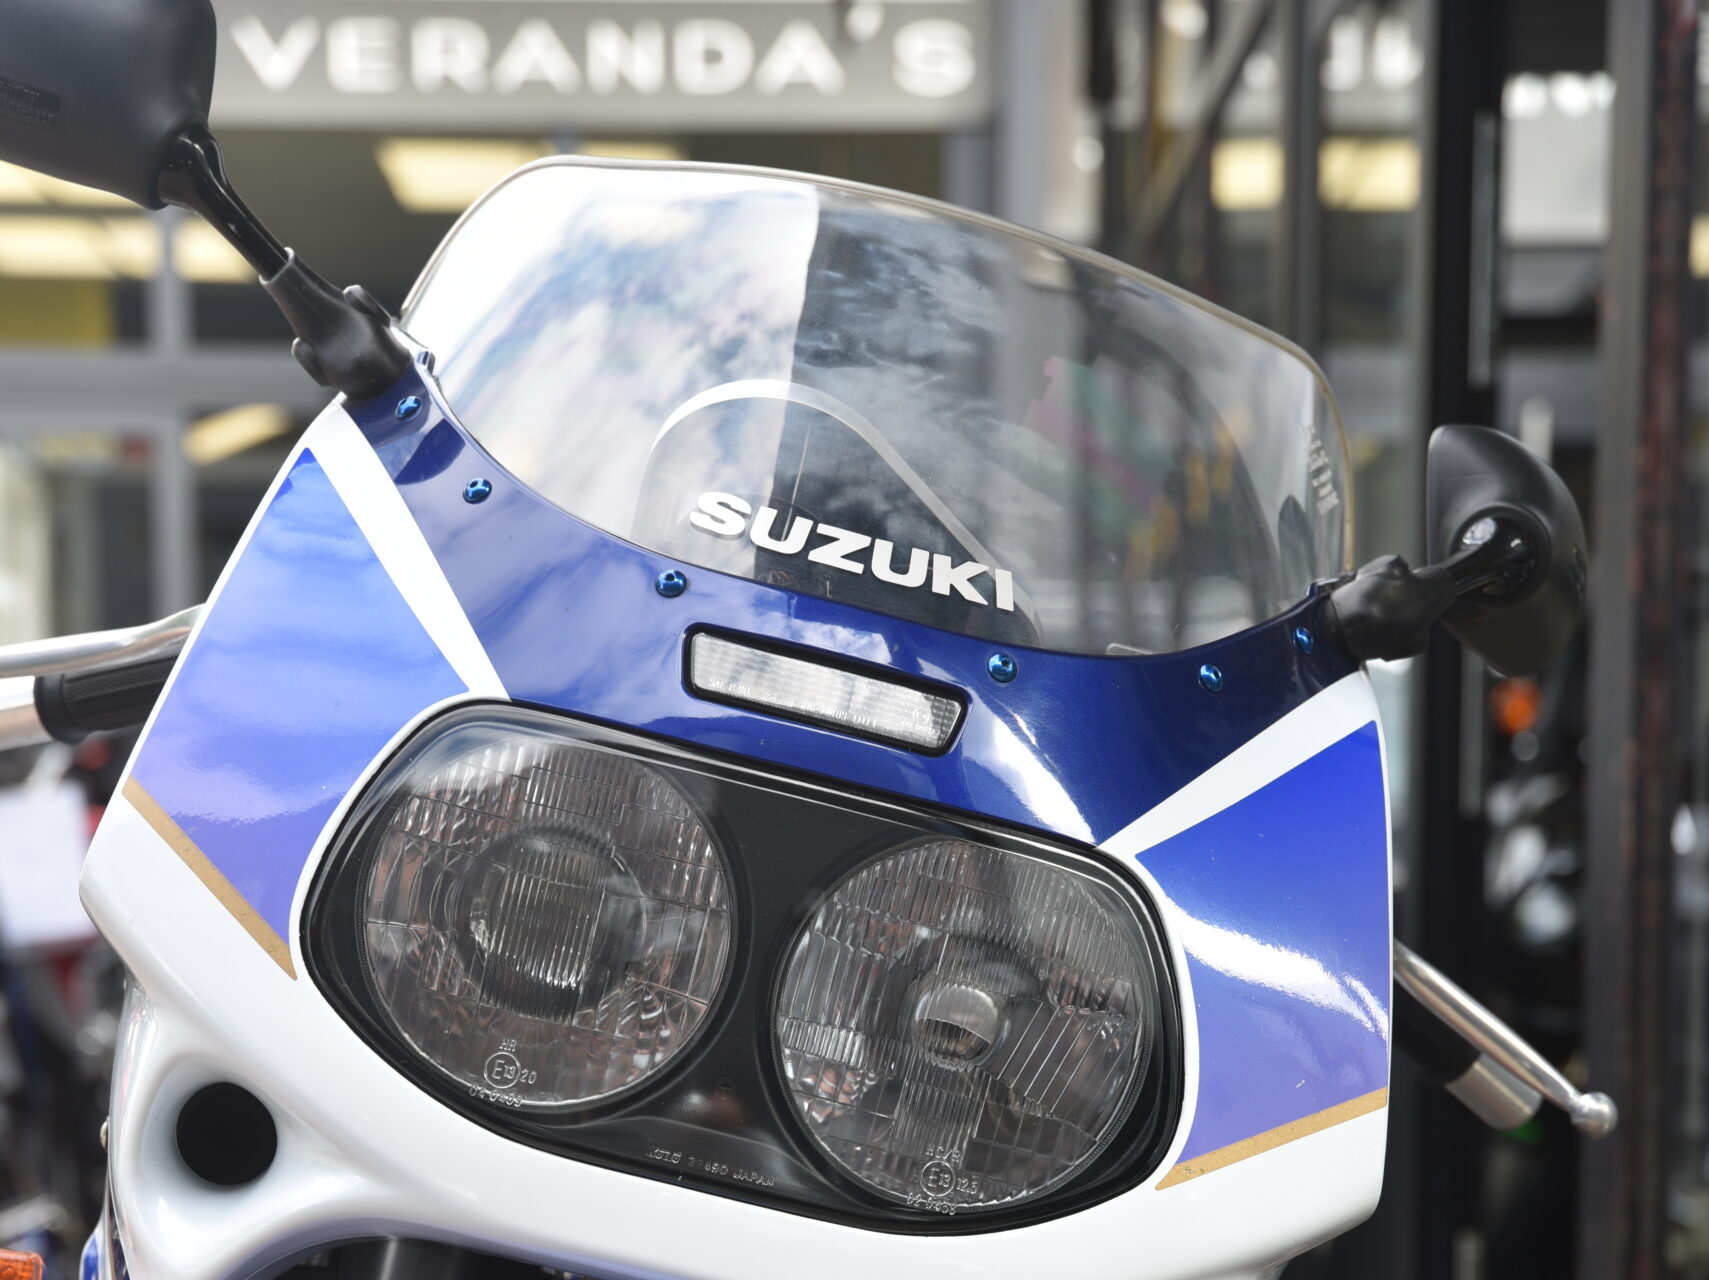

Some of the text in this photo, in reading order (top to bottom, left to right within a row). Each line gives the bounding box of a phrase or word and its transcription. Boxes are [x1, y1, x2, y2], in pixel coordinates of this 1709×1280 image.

[228, 0, 978, 98] VERANDA'S
[689, 491, 1014, 612] SUZUKI
[519, 1068, 538, 1085] 20
[733, 1167, 776, 1187] JAPAN
